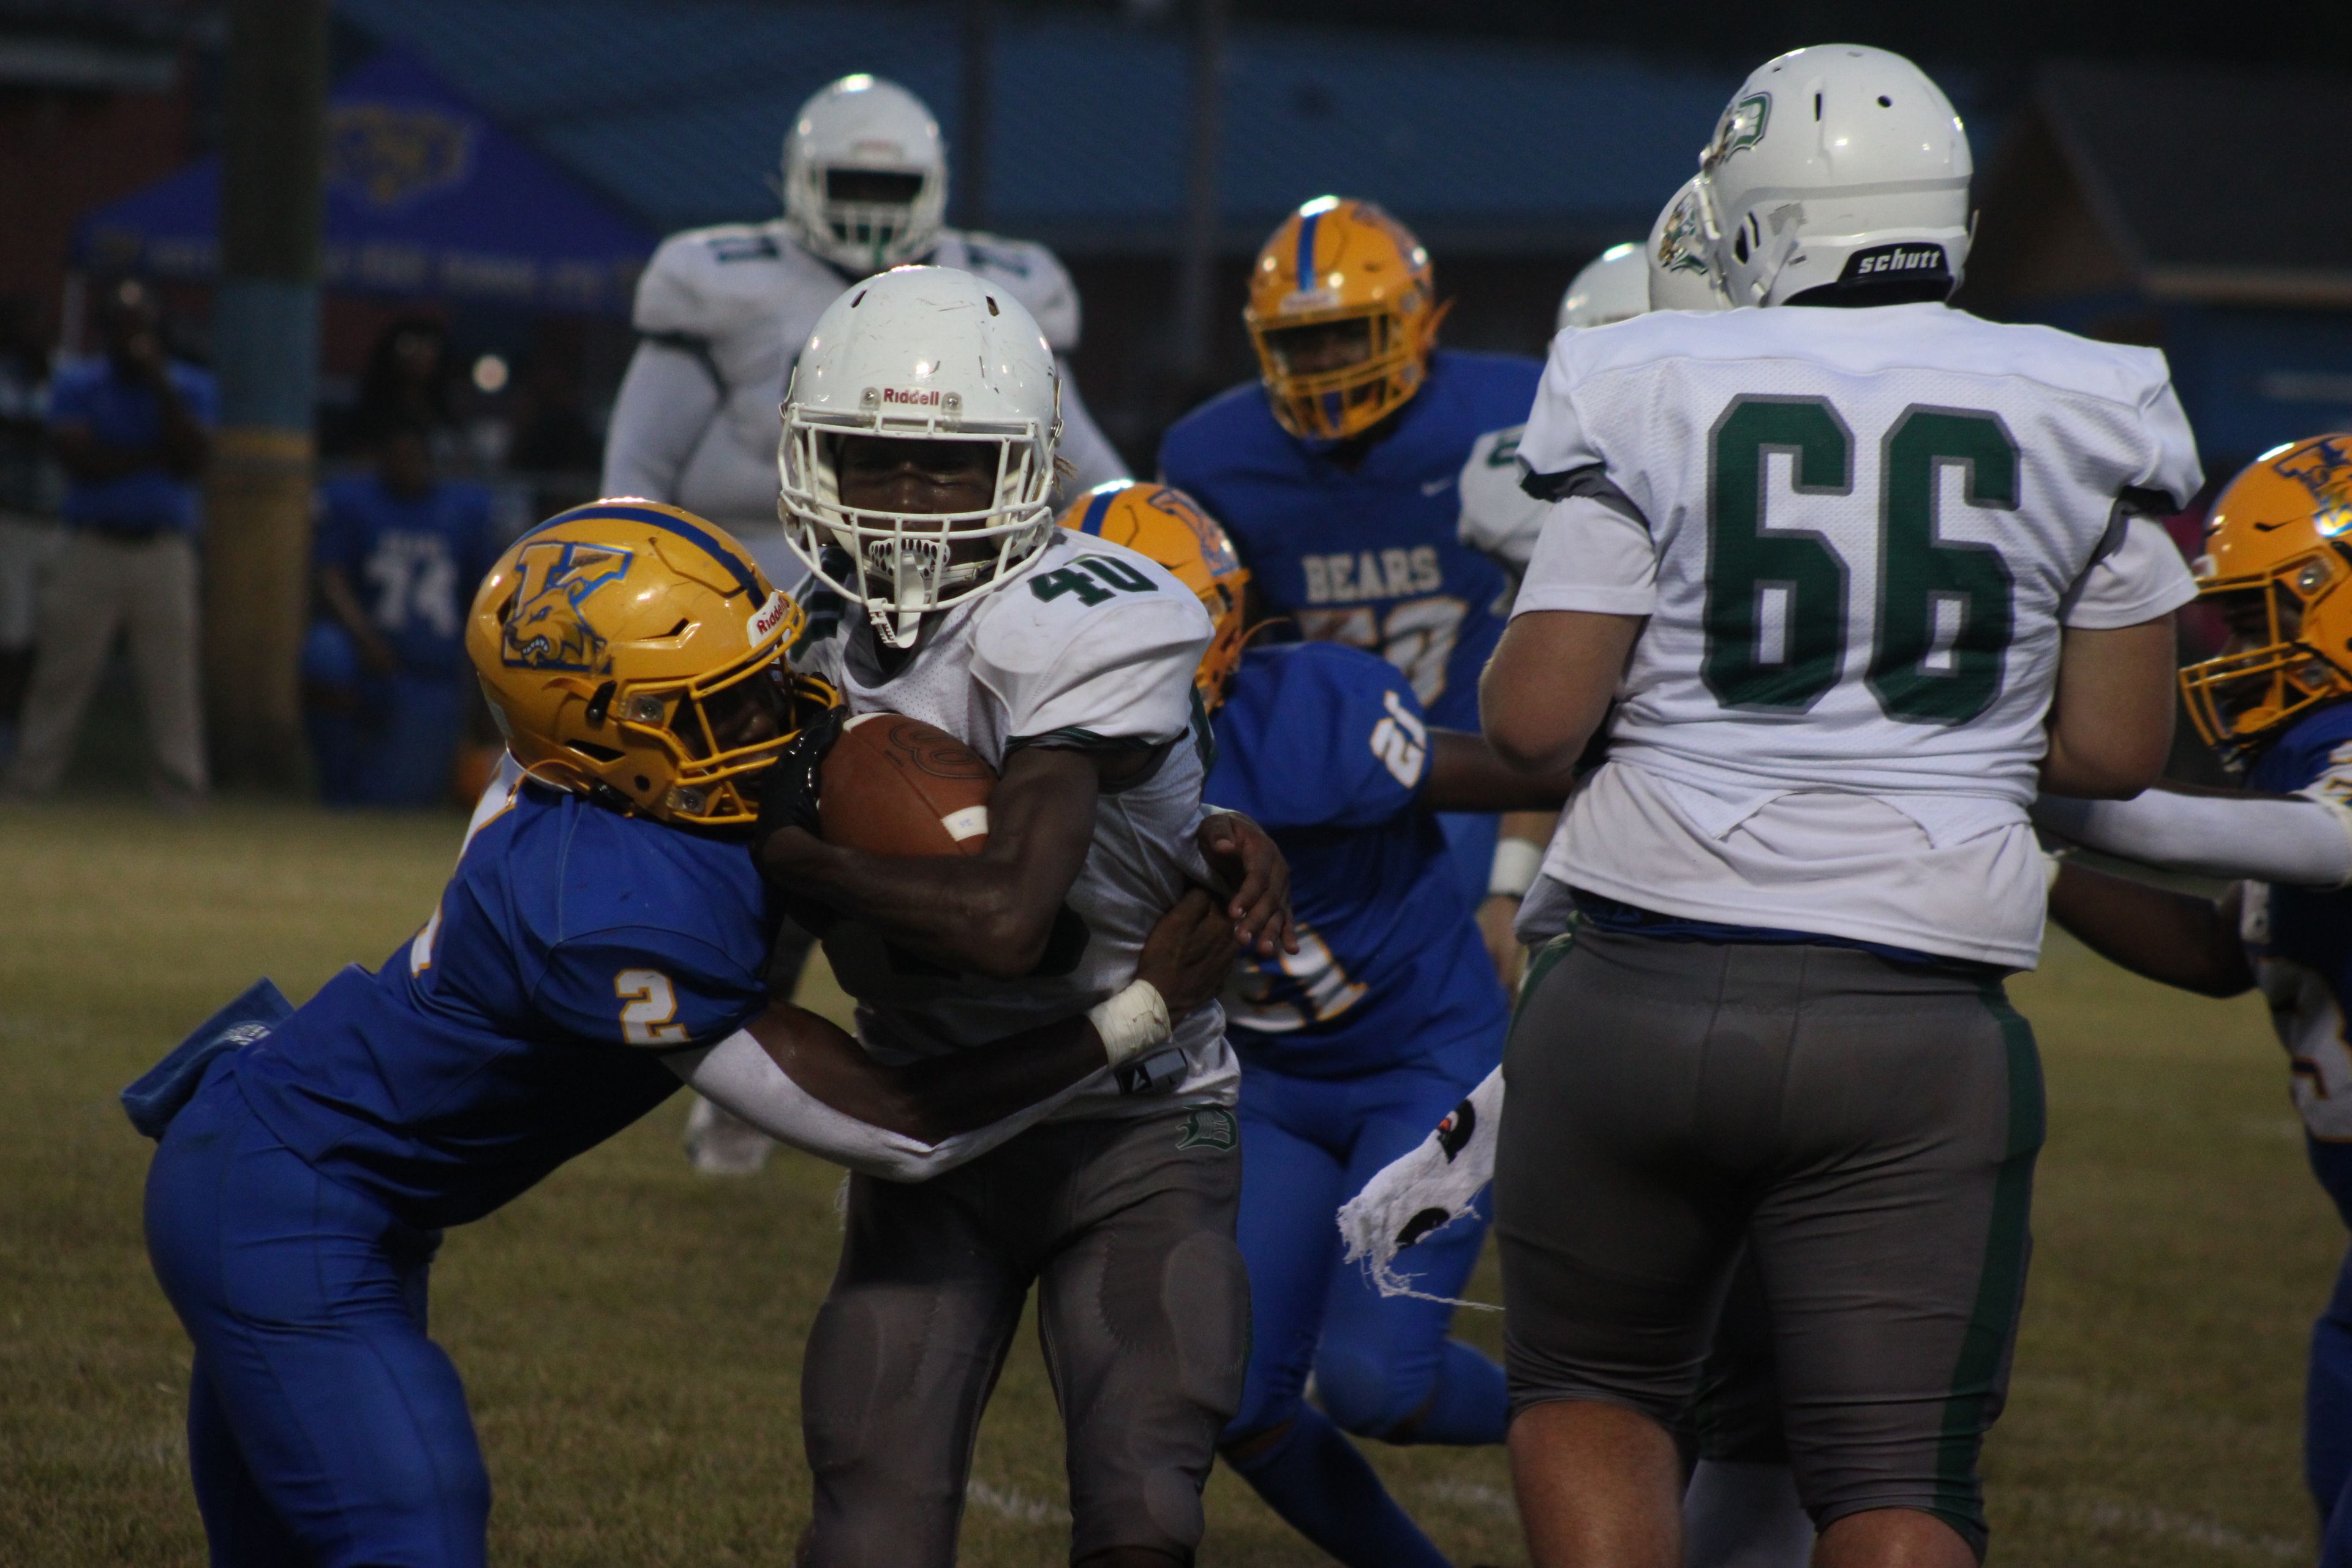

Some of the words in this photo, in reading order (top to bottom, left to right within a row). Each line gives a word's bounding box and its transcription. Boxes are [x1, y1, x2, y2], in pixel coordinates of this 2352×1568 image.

[1858, 248, 1940, 274] schutt
[883, 388, 940, 405] Riddell
[1027, 553, 1159, 607] 40
[1302, 545, 1443, 603] BEARS
[1700, 393, 2021, 727] 66
[1370, 690, 1427, 789] 21
[614, 968, 691, 1047] 2
